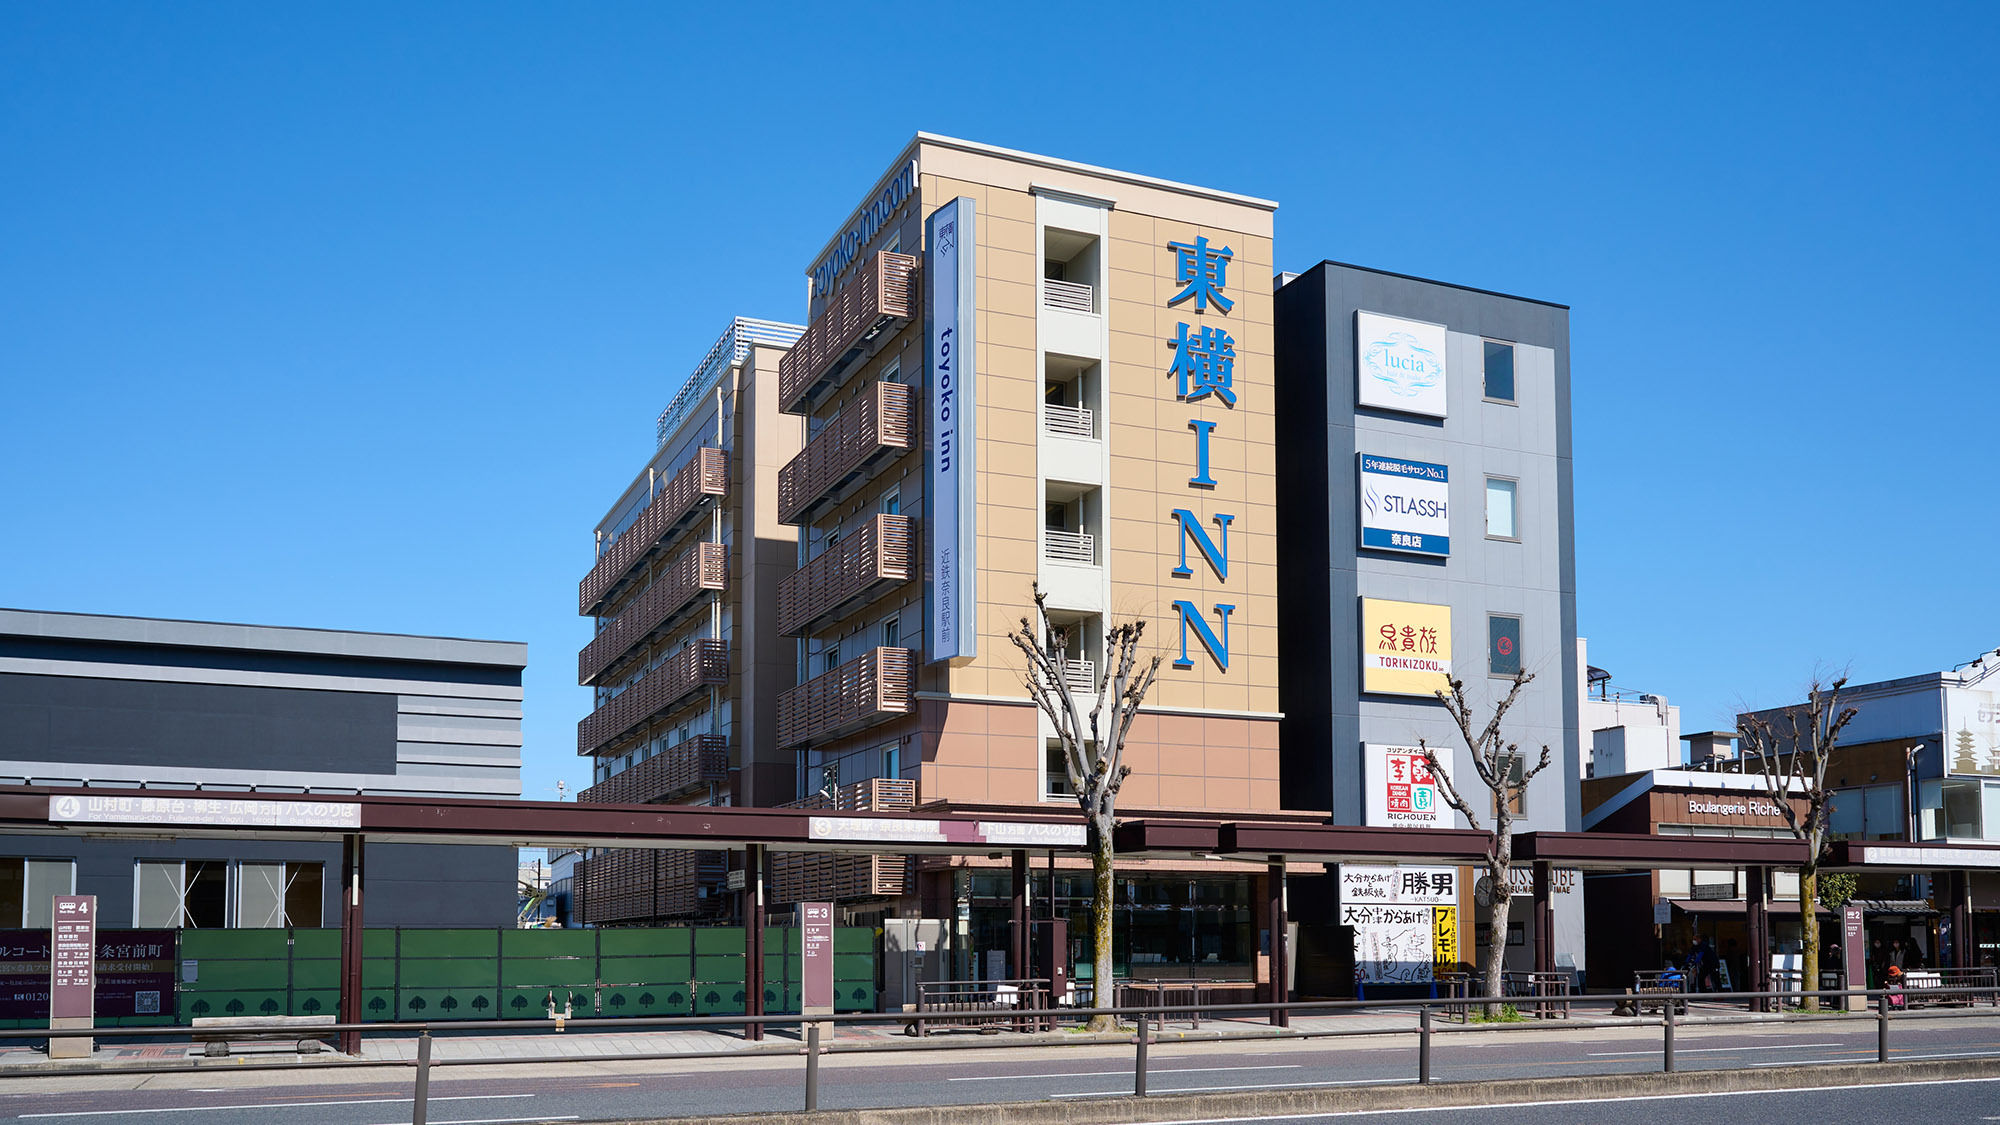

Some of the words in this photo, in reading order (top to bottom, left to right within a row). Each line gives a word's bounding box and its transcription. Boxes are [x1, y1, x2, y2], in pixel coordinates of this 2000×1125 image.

[813, 160, 918, 297] toyoko-inn.com
[1385, 349, 1425, 372] lucia
[938, 327, 953, 422] toyoko
[941, 429, 953, 473] inn
[1384, 494, 1447, 519] STLASSH
[1391, 533, 1422, 548] 奈良店
[941, 547, 950, 643] 近鉄奈良駅前
[1379, 656, 1438, 671] TORIKIZOKU
[1386, 747, 1425, 755] コリアンダイニ
[285, 803, 354, 817] バスのりば
[1689, 800, 1746, 815] Boulangerie
[1749, 801, 1781, 815] Riche
[1388, 813, 1436, 821] RICHOUEN
[1028, 823, 1081, 836] バスのりば
[1344, 873, 1392, 883] 大分からあげ
[1401, 872, 1453, 896] 勝男
[1351, 887, 1386, 898] 鉄板焼
[78, 901, 88, 914] 4
[821, 908, 828, 918] 3
[1855, 911, 1860, 919] 2
[95, 944, 163, 958] 条宮前町
[25, 992, 48, 1001] 0120
